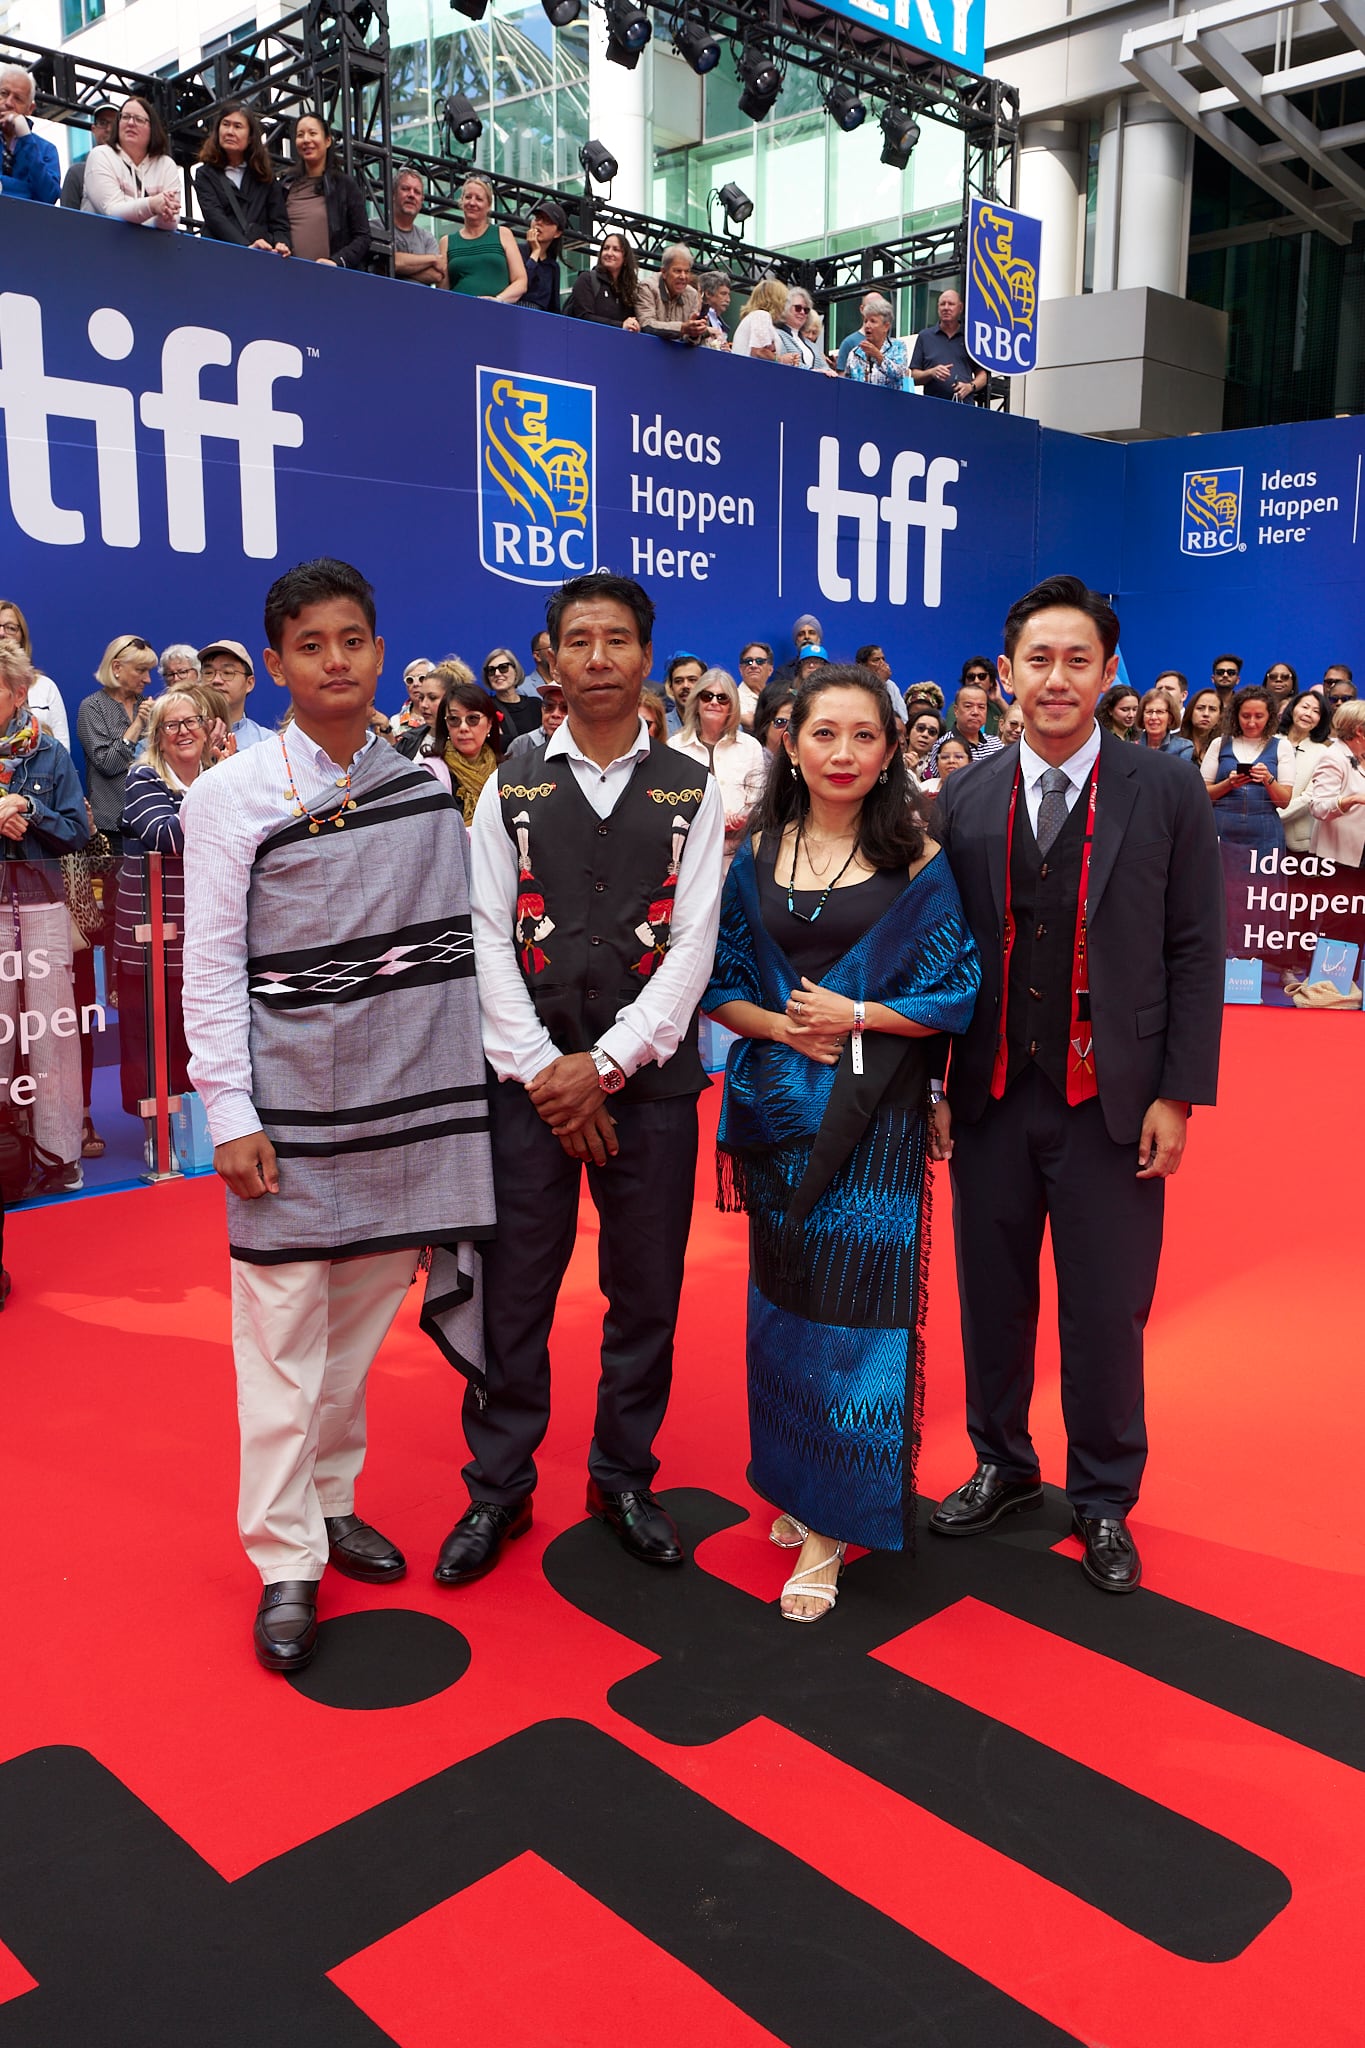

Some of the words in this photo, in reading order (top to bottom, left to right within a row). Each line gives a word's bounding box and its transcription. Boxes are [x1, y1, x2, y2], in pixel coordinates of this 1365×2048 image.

[974, 320, 1031, 367] RBC
[0, 291, 304, 560] tiff
[630, 413, 722, 466] Ideas
[1261, 469, 1318, 491] Ideas
[630, 474, 755, 533] Happen
[806, 435, 960, 608] tiff
[1259, 496, 1339, 521] Happen
[492, 521, 586, 570] RBC
[1187, 529, 1234, 550] RBC
[1258, 525, 1306, 545] Here
[630, 536, 709, 581] Here
[1250, 848, 1337, 877] Ideas
[1246, 885, 1365, 921] Happen
[1244, 923, 1317, 951] Here
